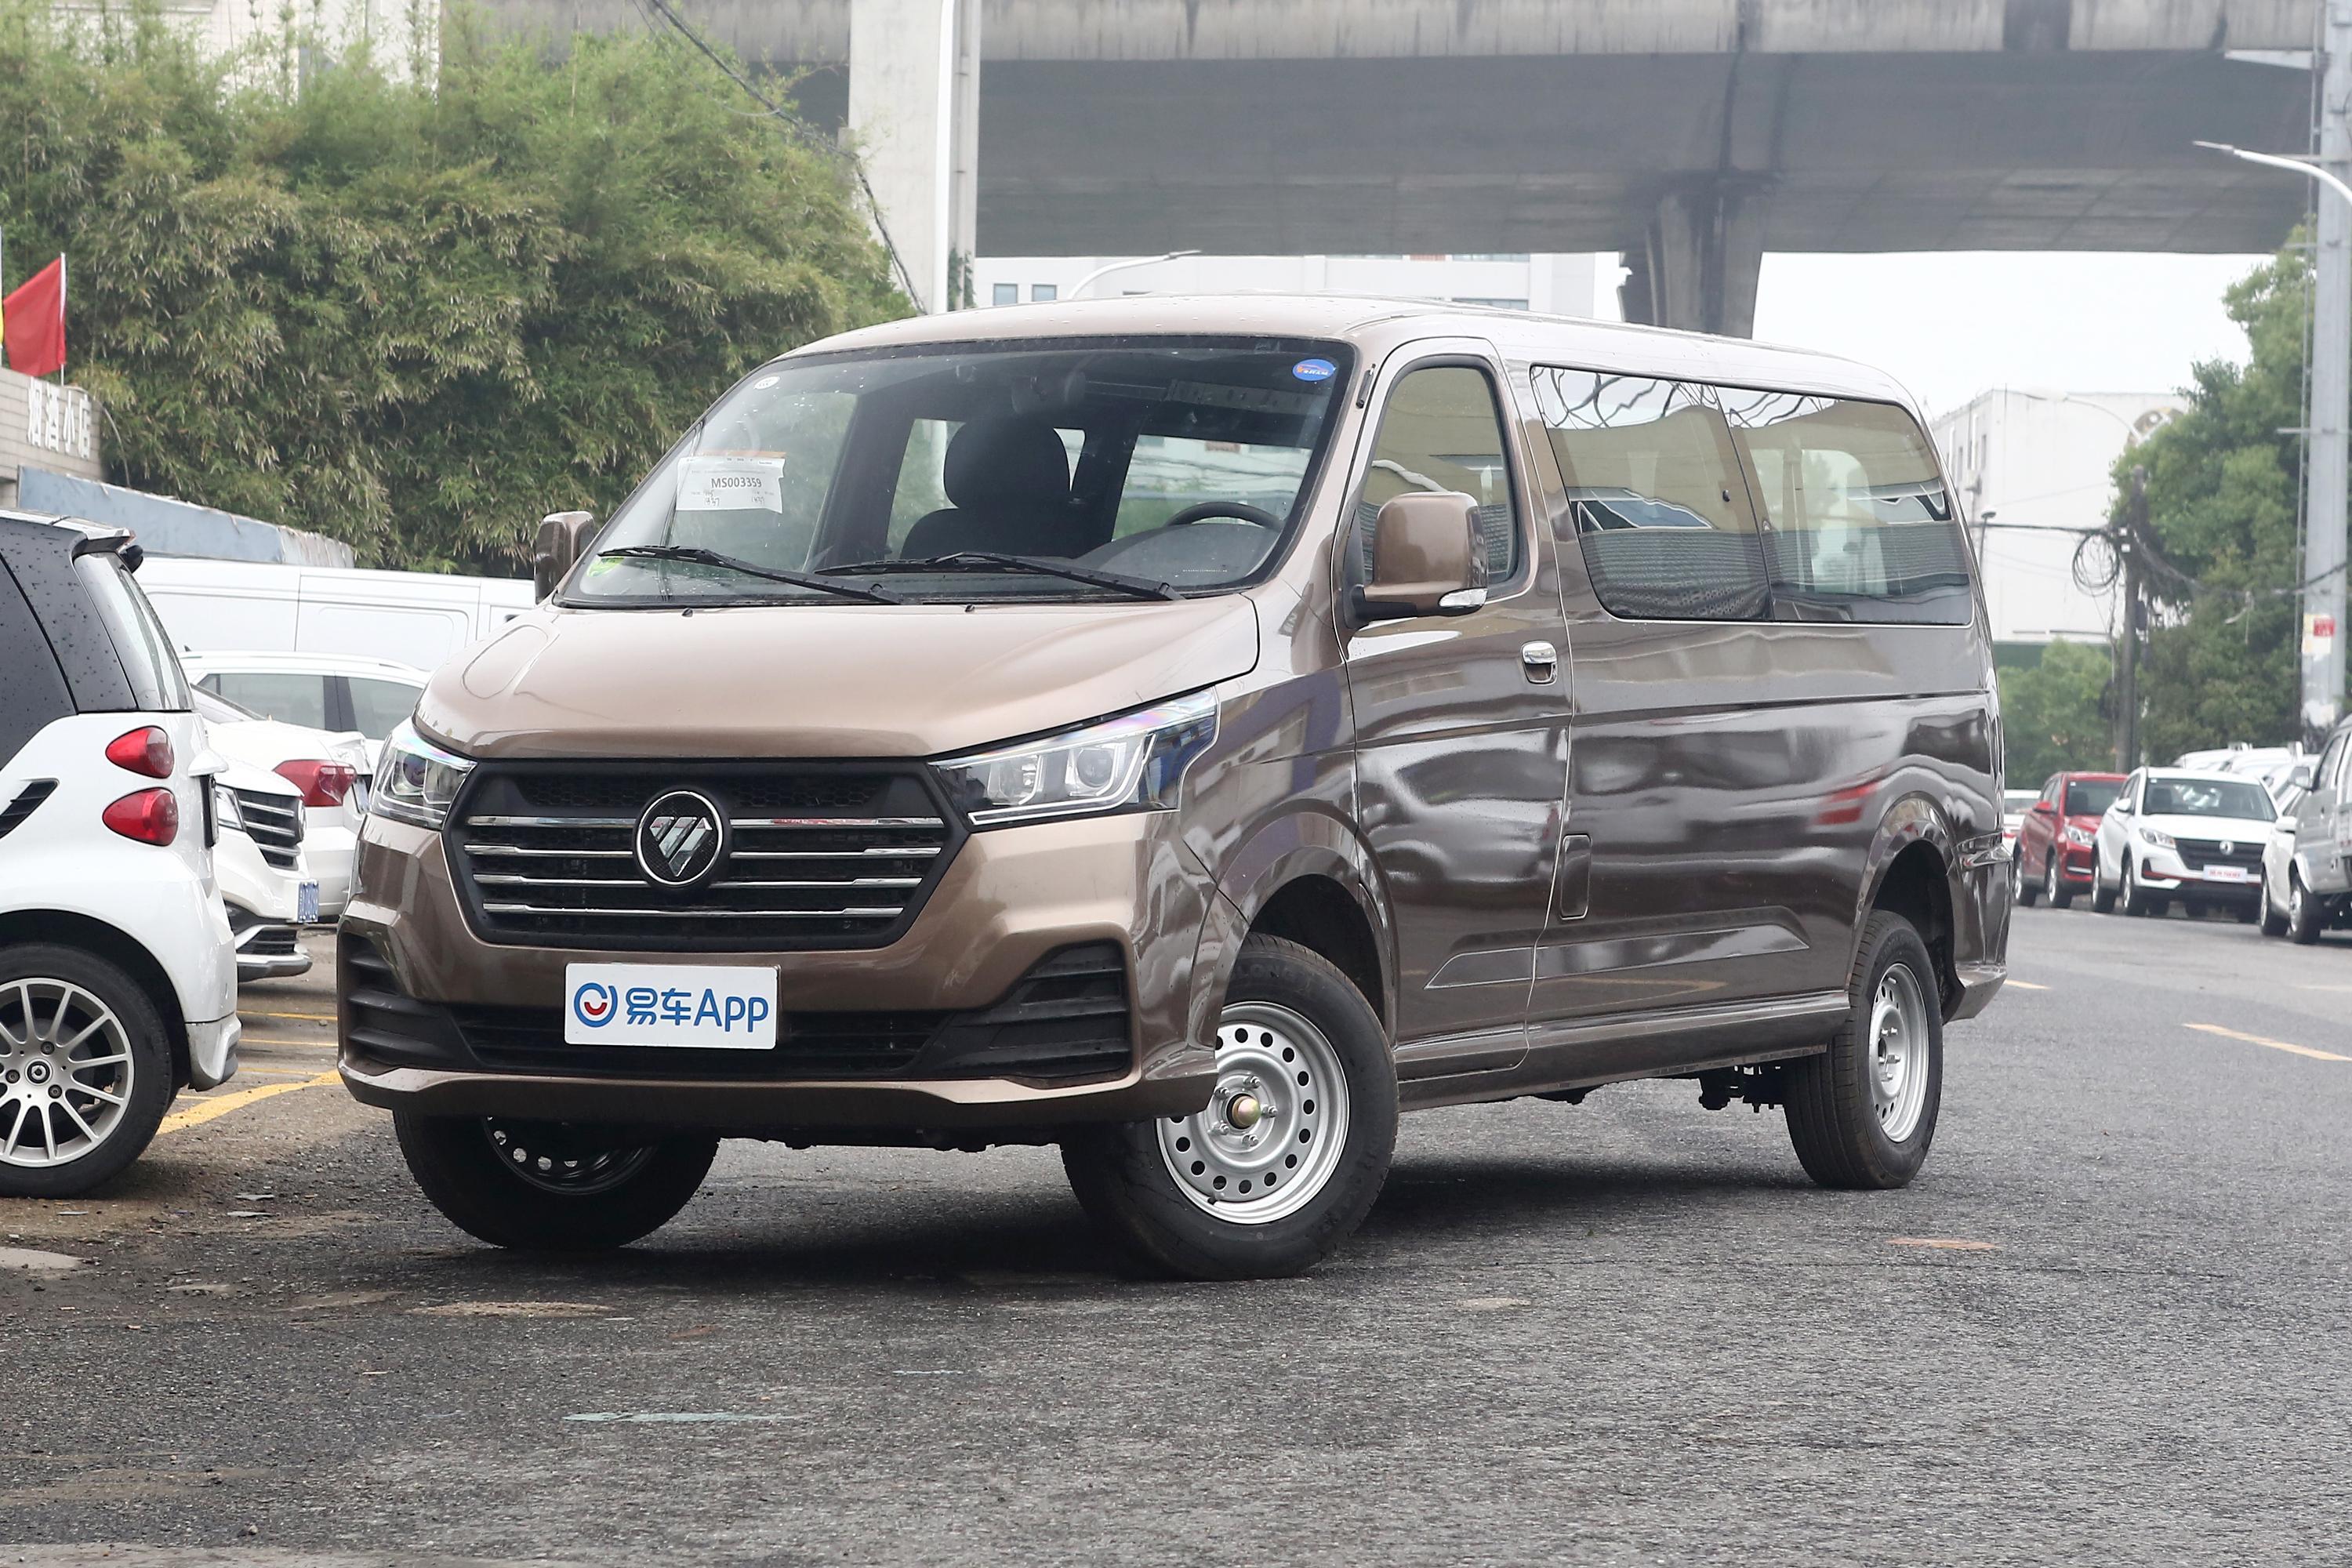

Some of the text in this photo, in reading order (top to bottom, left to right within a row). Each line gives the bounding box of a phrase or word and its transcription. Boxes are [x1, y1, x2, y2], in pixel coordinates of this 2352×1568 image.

[28, 376, 92, 459] 烟酒小店
[711, 477, 762, 488] MS003359
[626, 987, 769, 1033] 易车App
